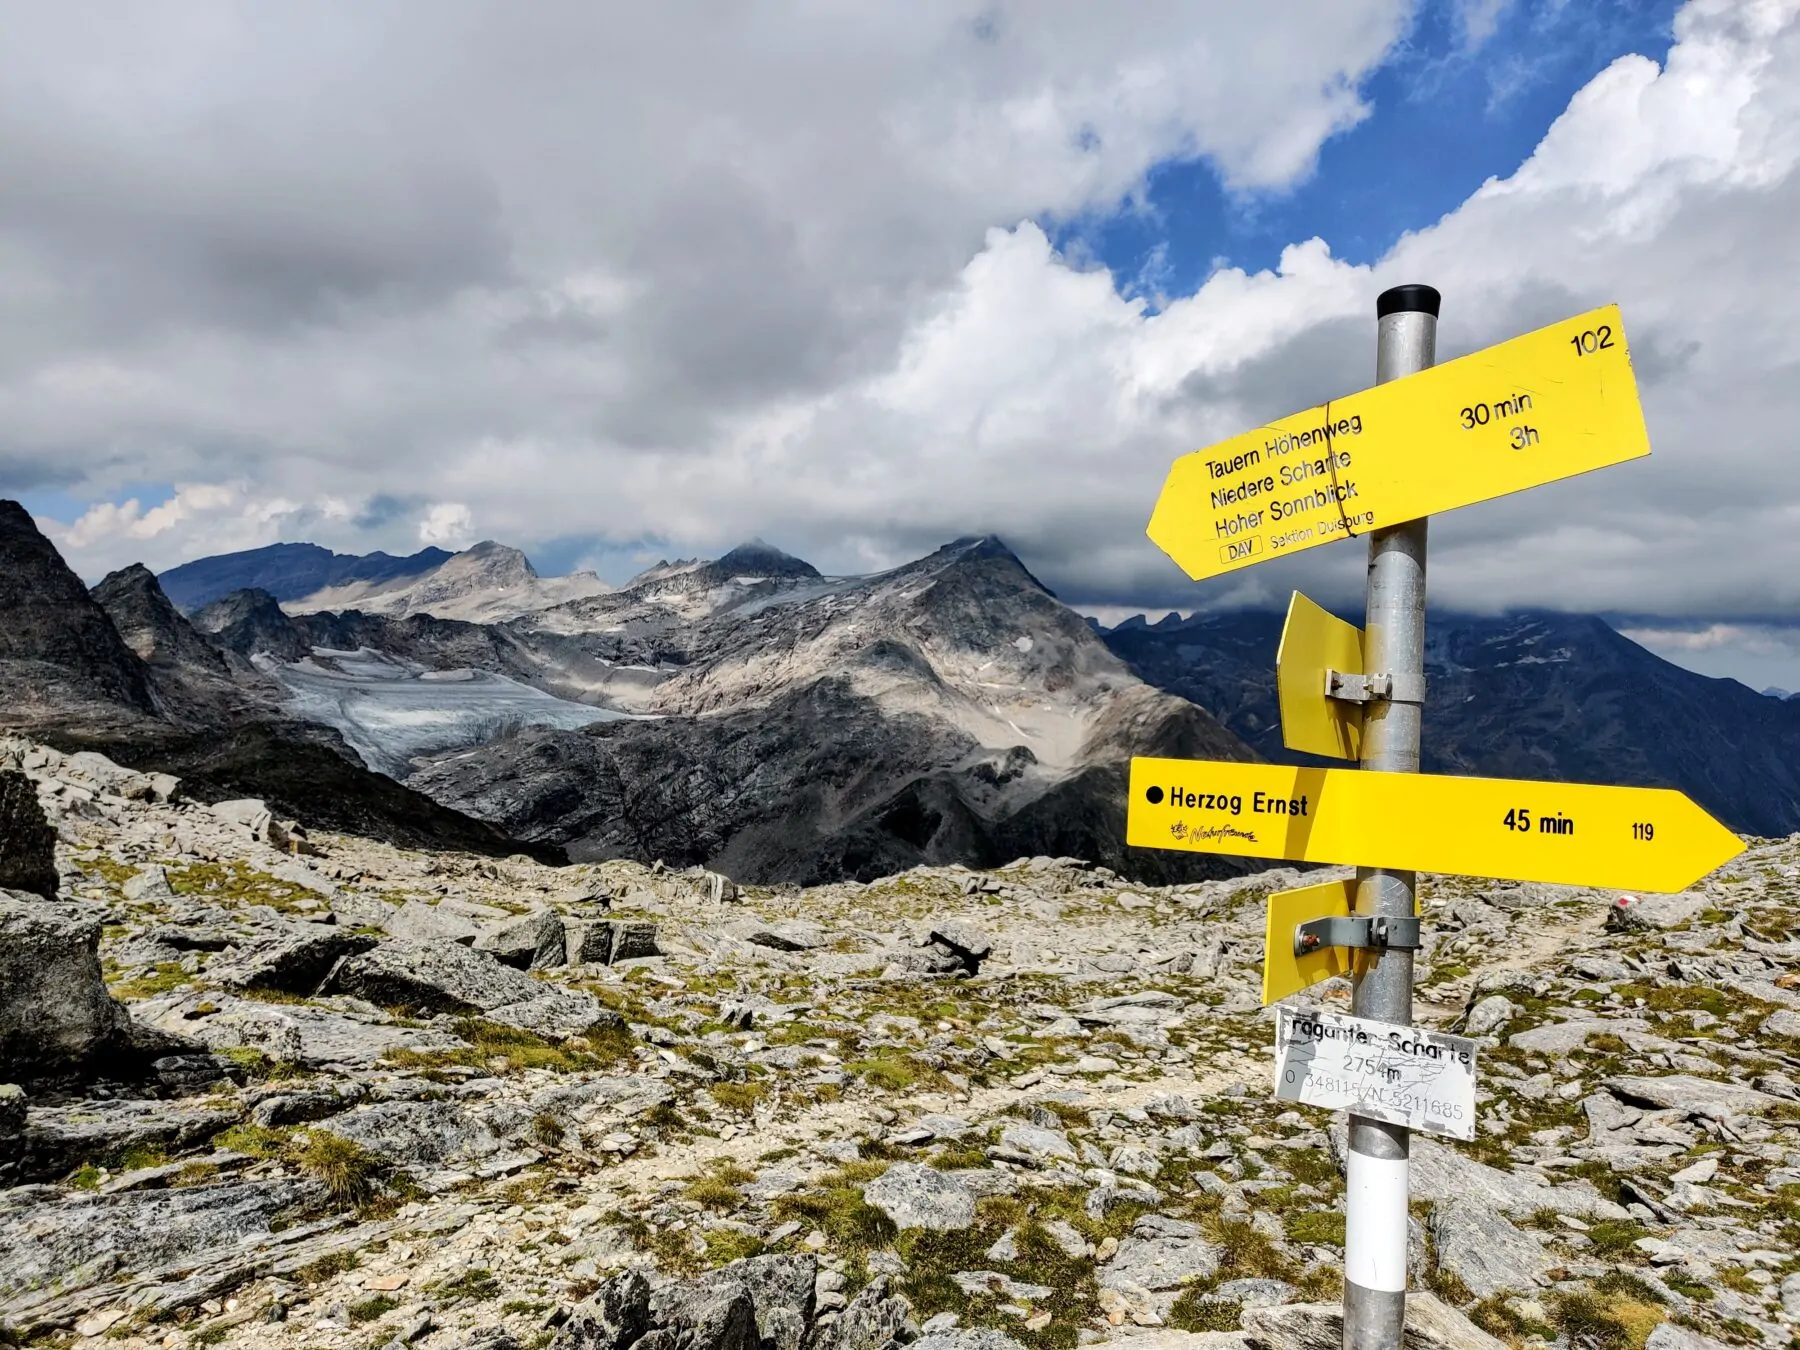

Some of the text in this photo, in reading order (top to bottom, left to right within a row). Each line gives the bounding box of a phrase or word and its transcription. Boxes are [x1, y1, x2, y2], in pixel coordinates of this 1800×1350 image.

[1571, 325, 1614, 356] 102
[1460, 393, 1532, 429] 30 min
[1205, 415, 1363, 479] Tauern Höhenweg
[1510, 425, 1540, 450] 3h
[1211, 451, 1351, 509] Niedere Scharte
[1216, 480, 1358, 538] Hoher Sonnblick
[1228, 510, 1374, 560] DAV Sektion Duisburg
[1170, 786, 1308, 816] Herzog Ernst
[1503, 808, 1574, 835] 45 min
[1631, 822, 1654, 841] 119
